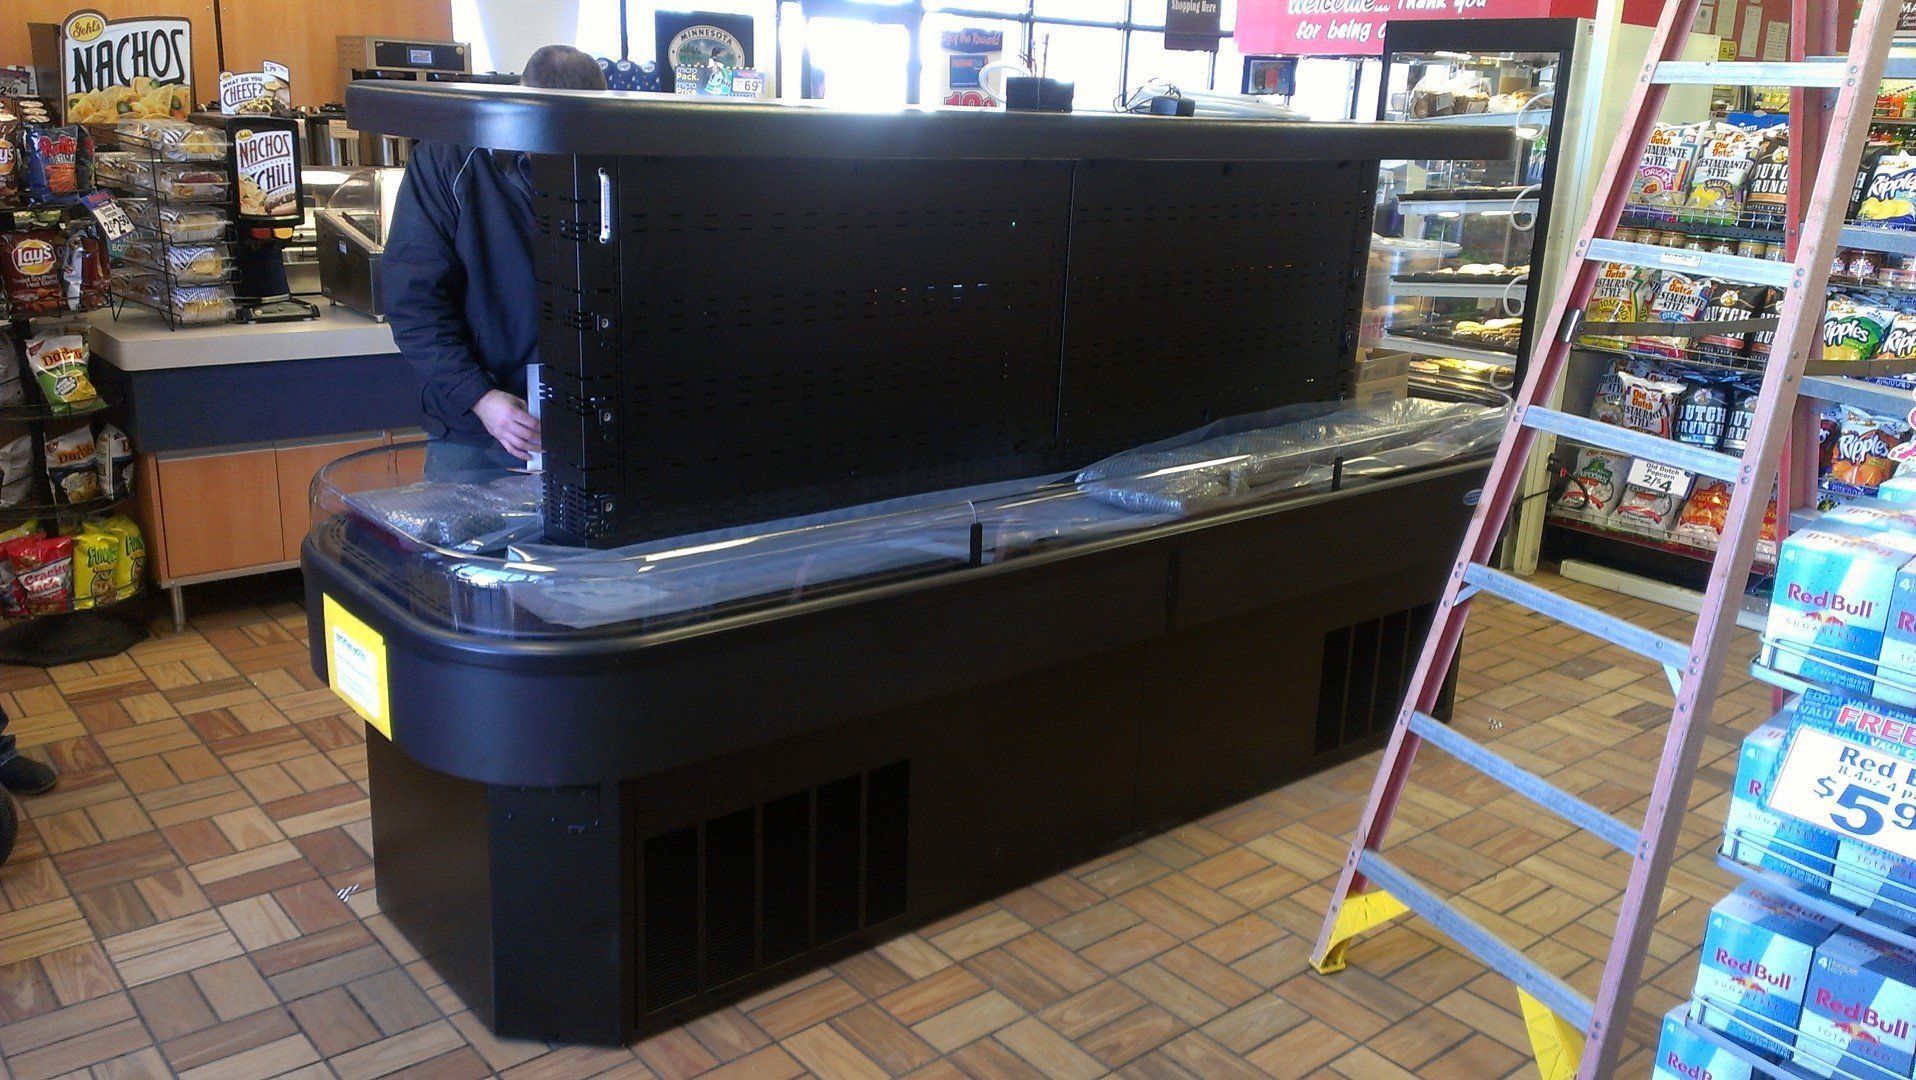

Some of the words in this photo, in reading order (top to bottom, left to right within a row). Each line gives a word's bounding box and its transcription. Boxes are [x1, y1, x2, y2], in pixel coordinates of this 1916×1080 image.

[680, 28, 733, 45] MINNESOTA
[1296, 20, 1322, 39] for
[1327, 19, 1372, 42] being
[72, 29, 185, 93] NACHOS
[222, 79, 239, 88] WHAT
[676, 73, 699, 81] Pack.
[223, 82, 264, 107] CHEESE?
[239, 133, 290, 168] NACHOS
[1644, 156, 1668, 167] STYLE
[256, 162, 293, 192] CHILI
[1707, 168, 1729, 178] STYLE
[1599, 287, 1622, 298] STYLE
[1662, 301, 1686, 313] STYLE
[1633, 389, 1647, 399] Old
[1632, 397, 1653, 410] Dutch
[1839, 434, 1888, 463] Ripples
[1646, 462, 1658, 471] Old
[1647, 468, 1675, 480] Popcorn
[1788, 583, 1829, 608] Red
[1831, 594, 1873, 618] Bull
[1839, 746, 1898, 779] Red
[1715, 947, 1753, 975] Red
[1754, 963, 1792, 990] Bull
[1818, 956, 1829, 968] 4
[1815, 986, 1862, 1021] Red
[1862, 1006, 1910, 1040] Bull
[1667, 1051, 1701, 1080] Red
